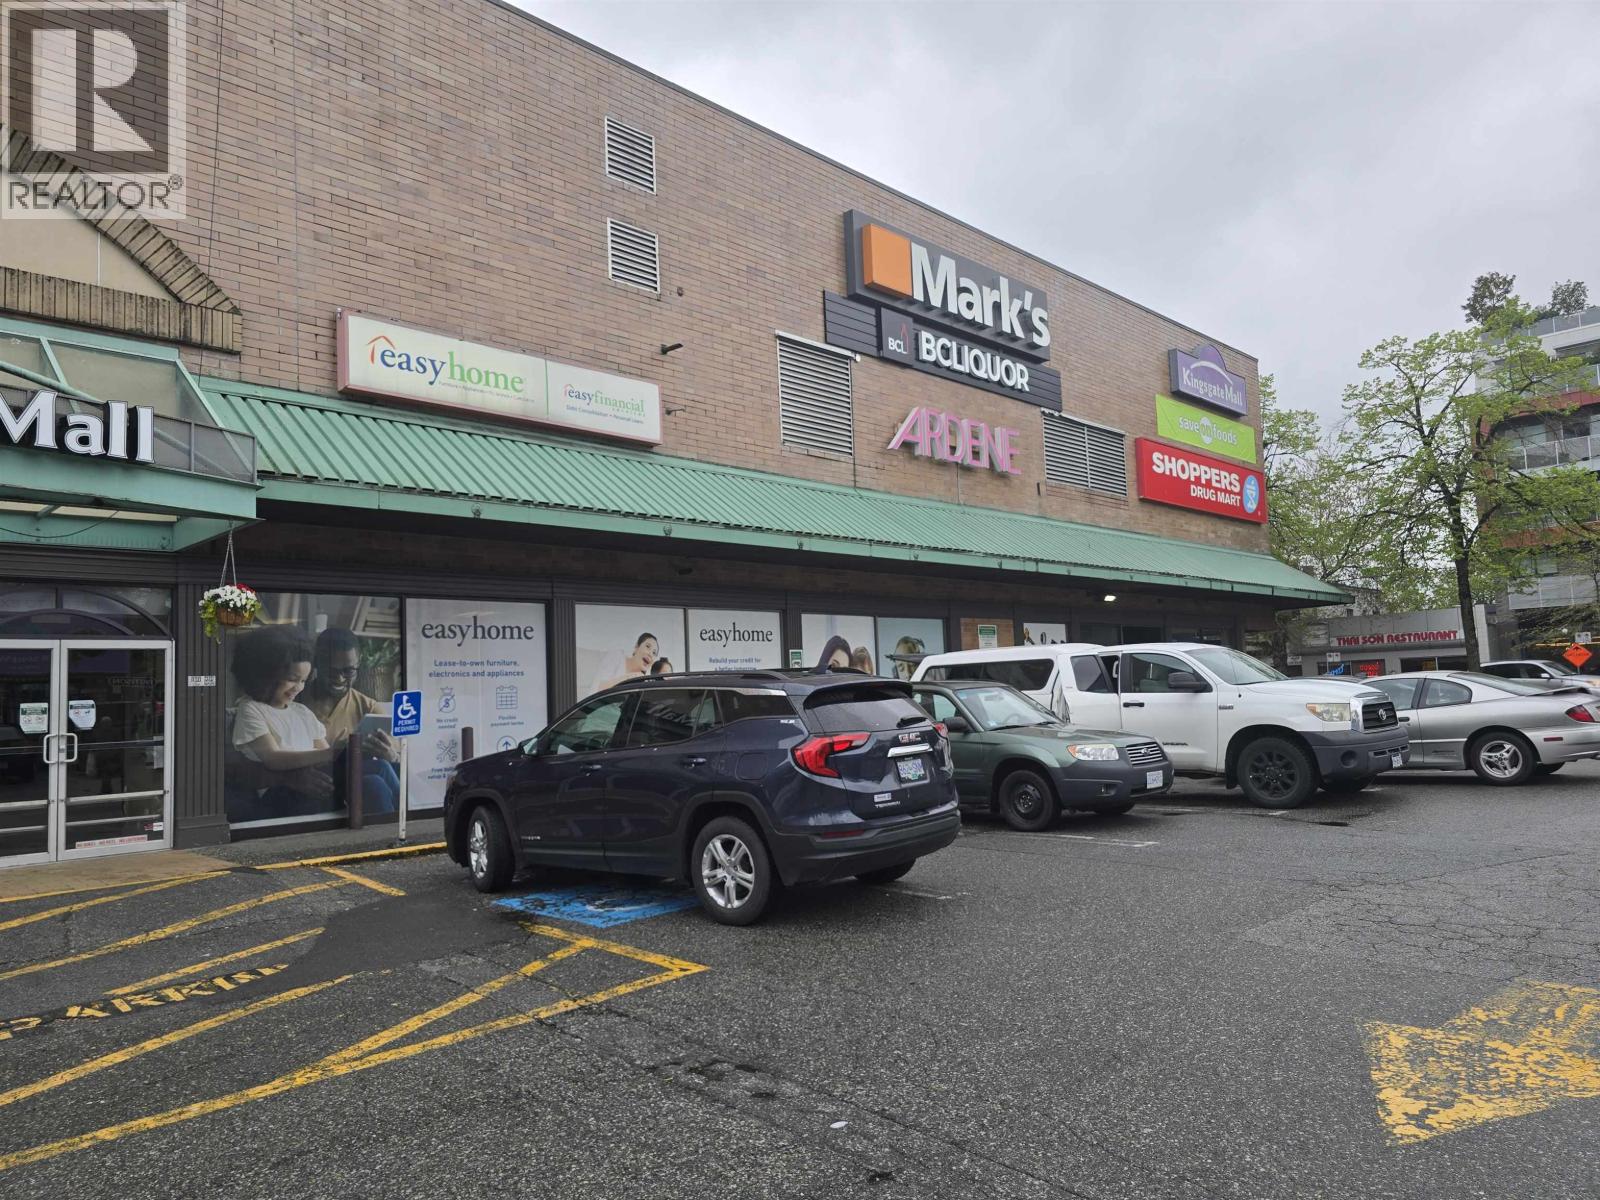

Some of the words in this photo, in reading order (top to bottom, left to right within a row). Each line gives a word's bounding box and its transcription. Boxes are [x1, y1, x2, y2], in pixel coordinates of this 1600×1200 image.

[911, 241, 1050, 347] Mark's
[888, 336, 908, 355] BCL
[0, 389, 155, 464] Mall
[1211, 424, 1237, 445] foods
[887, 406, 1022, 475] ARDENE
[1152, 451, 1241, 493] SHOPPERS
[1190, 485, 1216, 501] DRUG
[1217, 491, 1241, 507] MART
[421, 615, 535, 647] easyhome
[700, 622, 773, 648] easyhome
[1336, 635, 1360, 646] THAI
[1361, 634, 1385, 646] SON
[1387, 630, 1458, 644] RESTAURANT
[434, 659, 485, 667] Lease-to-own
[428, 670, 470, 678] electronics
[472, 670, 485, 678] and
[487, 670, 525, 679] appliances
[394, 725, 419, 733] REQUIRED
